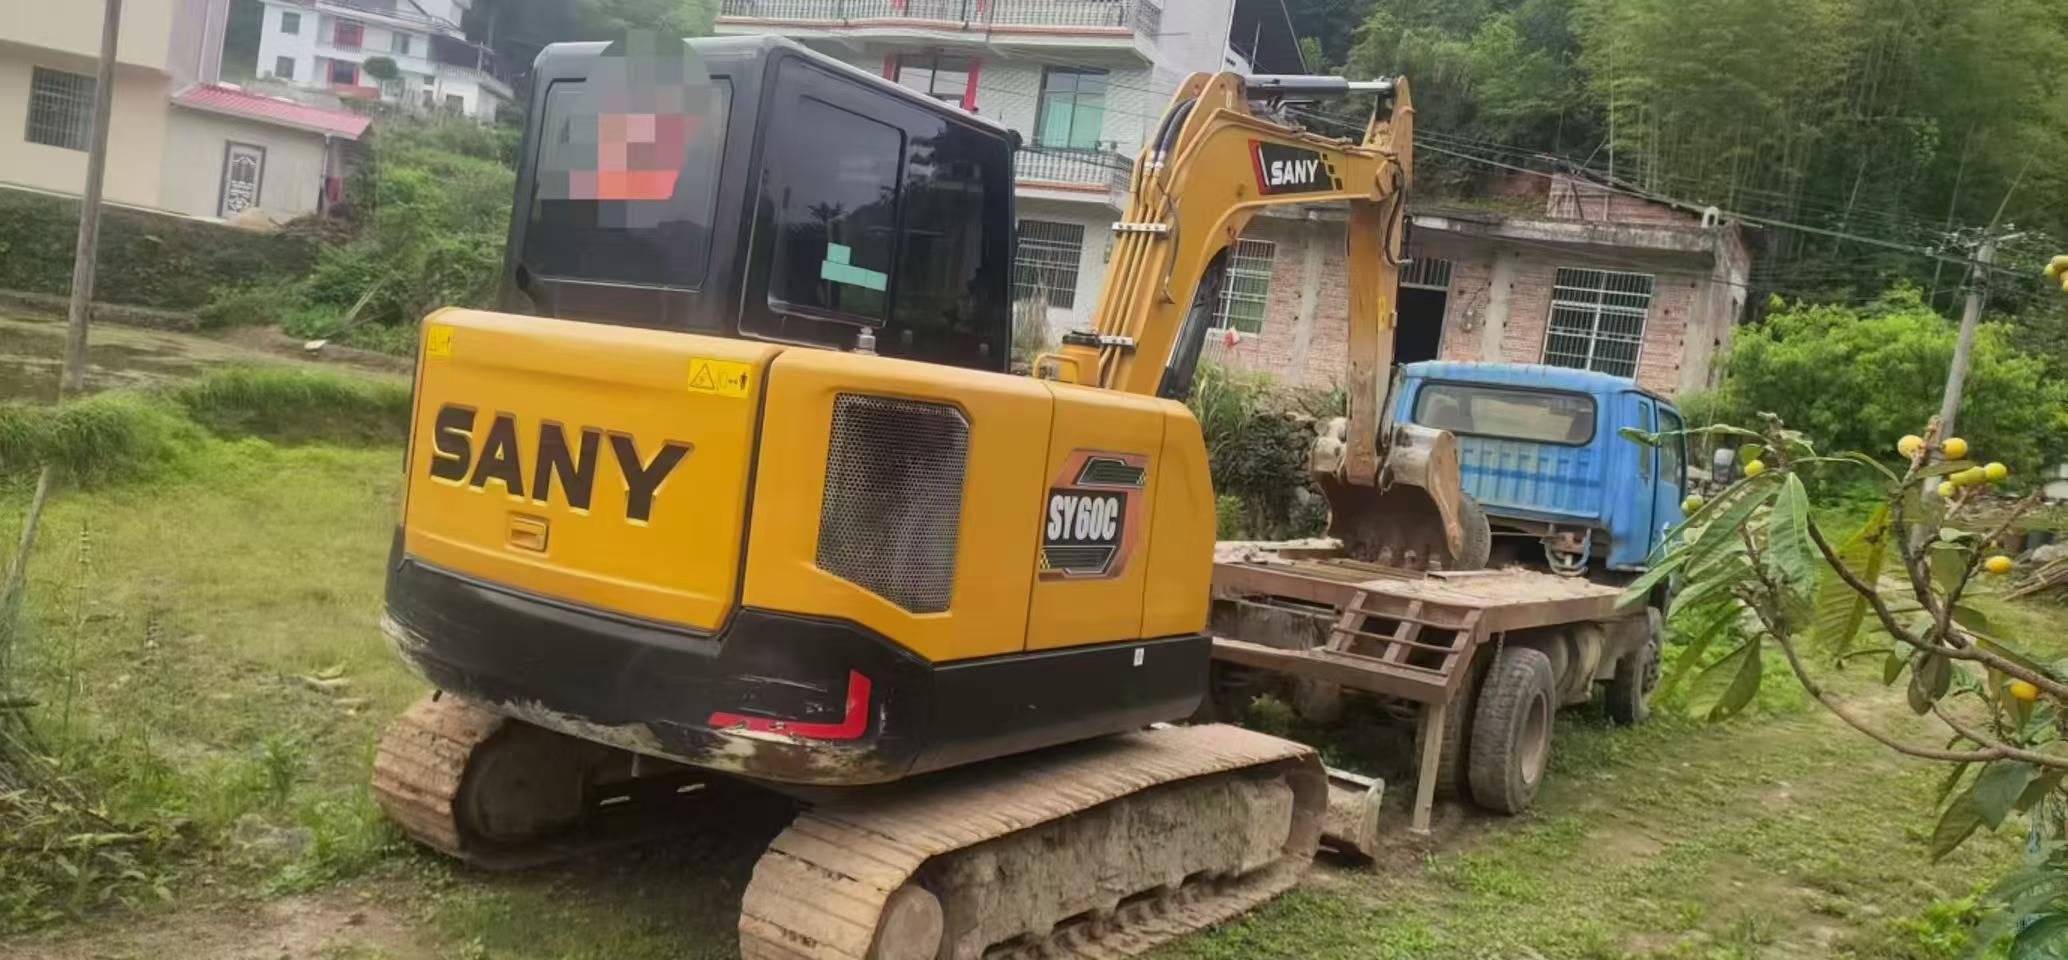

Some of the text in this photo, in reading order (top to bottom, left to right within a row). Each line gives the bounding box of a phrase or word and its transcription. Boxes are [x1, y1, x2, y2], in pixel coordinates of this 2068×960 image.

[1271, 159, 1318, 185] SANY
[430, 402, 694, 527] SANY
[1047, 494, 1119, 541] SY60C
